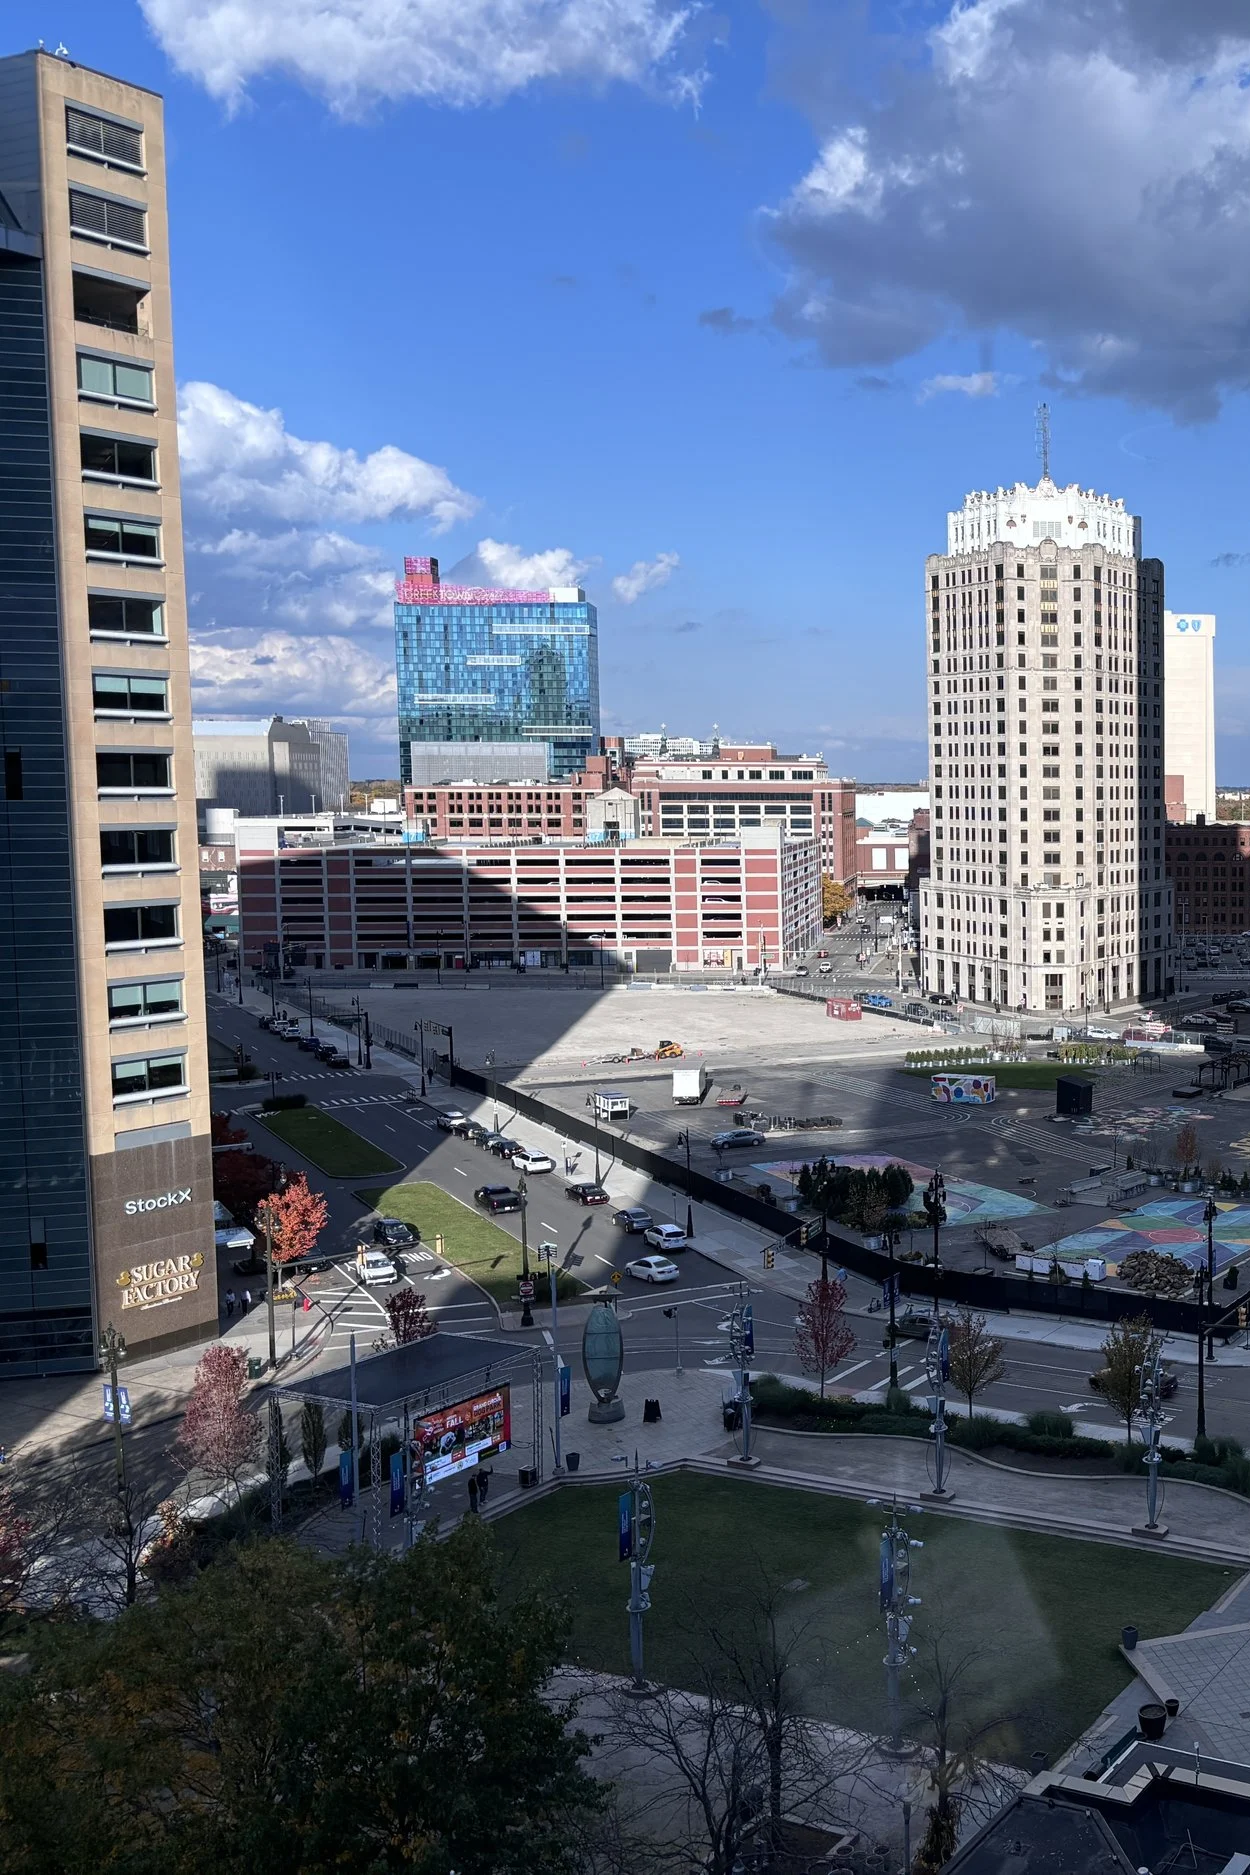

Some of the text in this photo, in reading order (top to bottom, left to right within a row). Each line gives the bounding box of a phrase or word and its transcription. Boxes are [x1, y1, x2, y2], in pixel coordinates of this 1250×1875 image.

[125, 1188, 192, 1215] StockX
[130, 1255, 191, 1284] SUGAR
[122, 1271, 200, 1307] FACTORY
[446, 1416, 464, 1428] FALL
